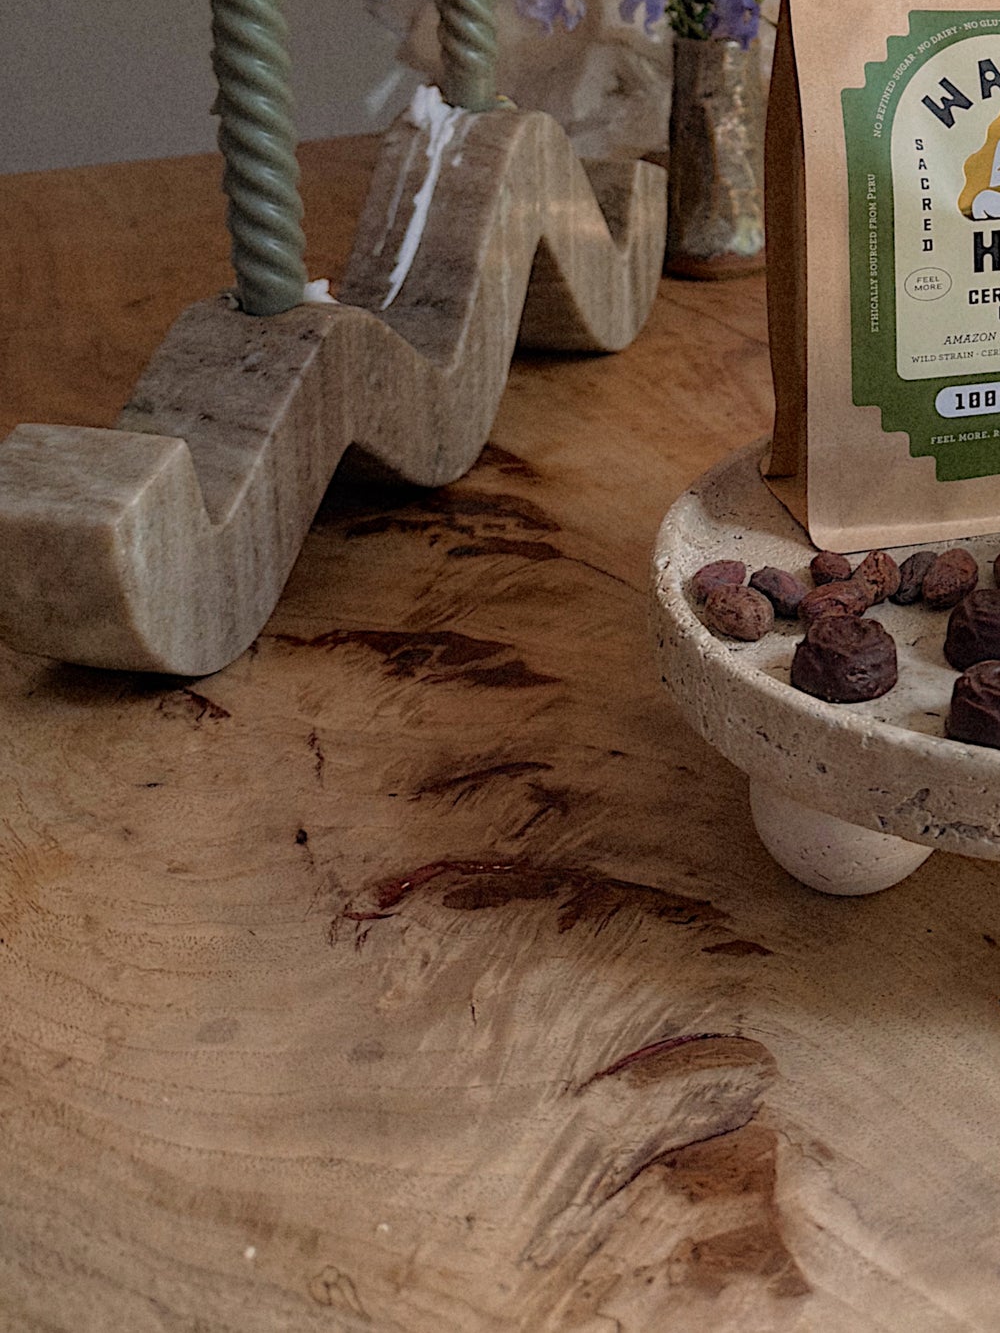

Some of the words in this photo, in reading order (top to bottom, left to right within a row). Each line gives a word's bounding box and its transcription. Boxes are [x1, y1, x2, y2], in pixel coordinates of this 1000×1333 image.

[963, 21, 978, 31] NO
[930, 26, 959, 44] DAIRY
[917, 40, 931, 54] NO
[892, 53, 916, 81] SUGAR
[876, 80, 896, 122] REFINED
[874, 122, 883, 138] NO
[915, 139, 934, 252] SACRED
[868, 202, 878, 229] FROM
[869, 232, 879, 276] SOURCED
[914, 284, 943, 292] MORE
[916, 276, 940, 284] FEEL
[870, 278, 880, 333] ETHICALLY
[943, 331, 997, 346] AMAZON
[911, 354, 937, 363] WILD
[938, 351, 974, 361] STRAIN
[930, 434, 956, 444] FEEL
[958, 430, 991, 442] MORE.
